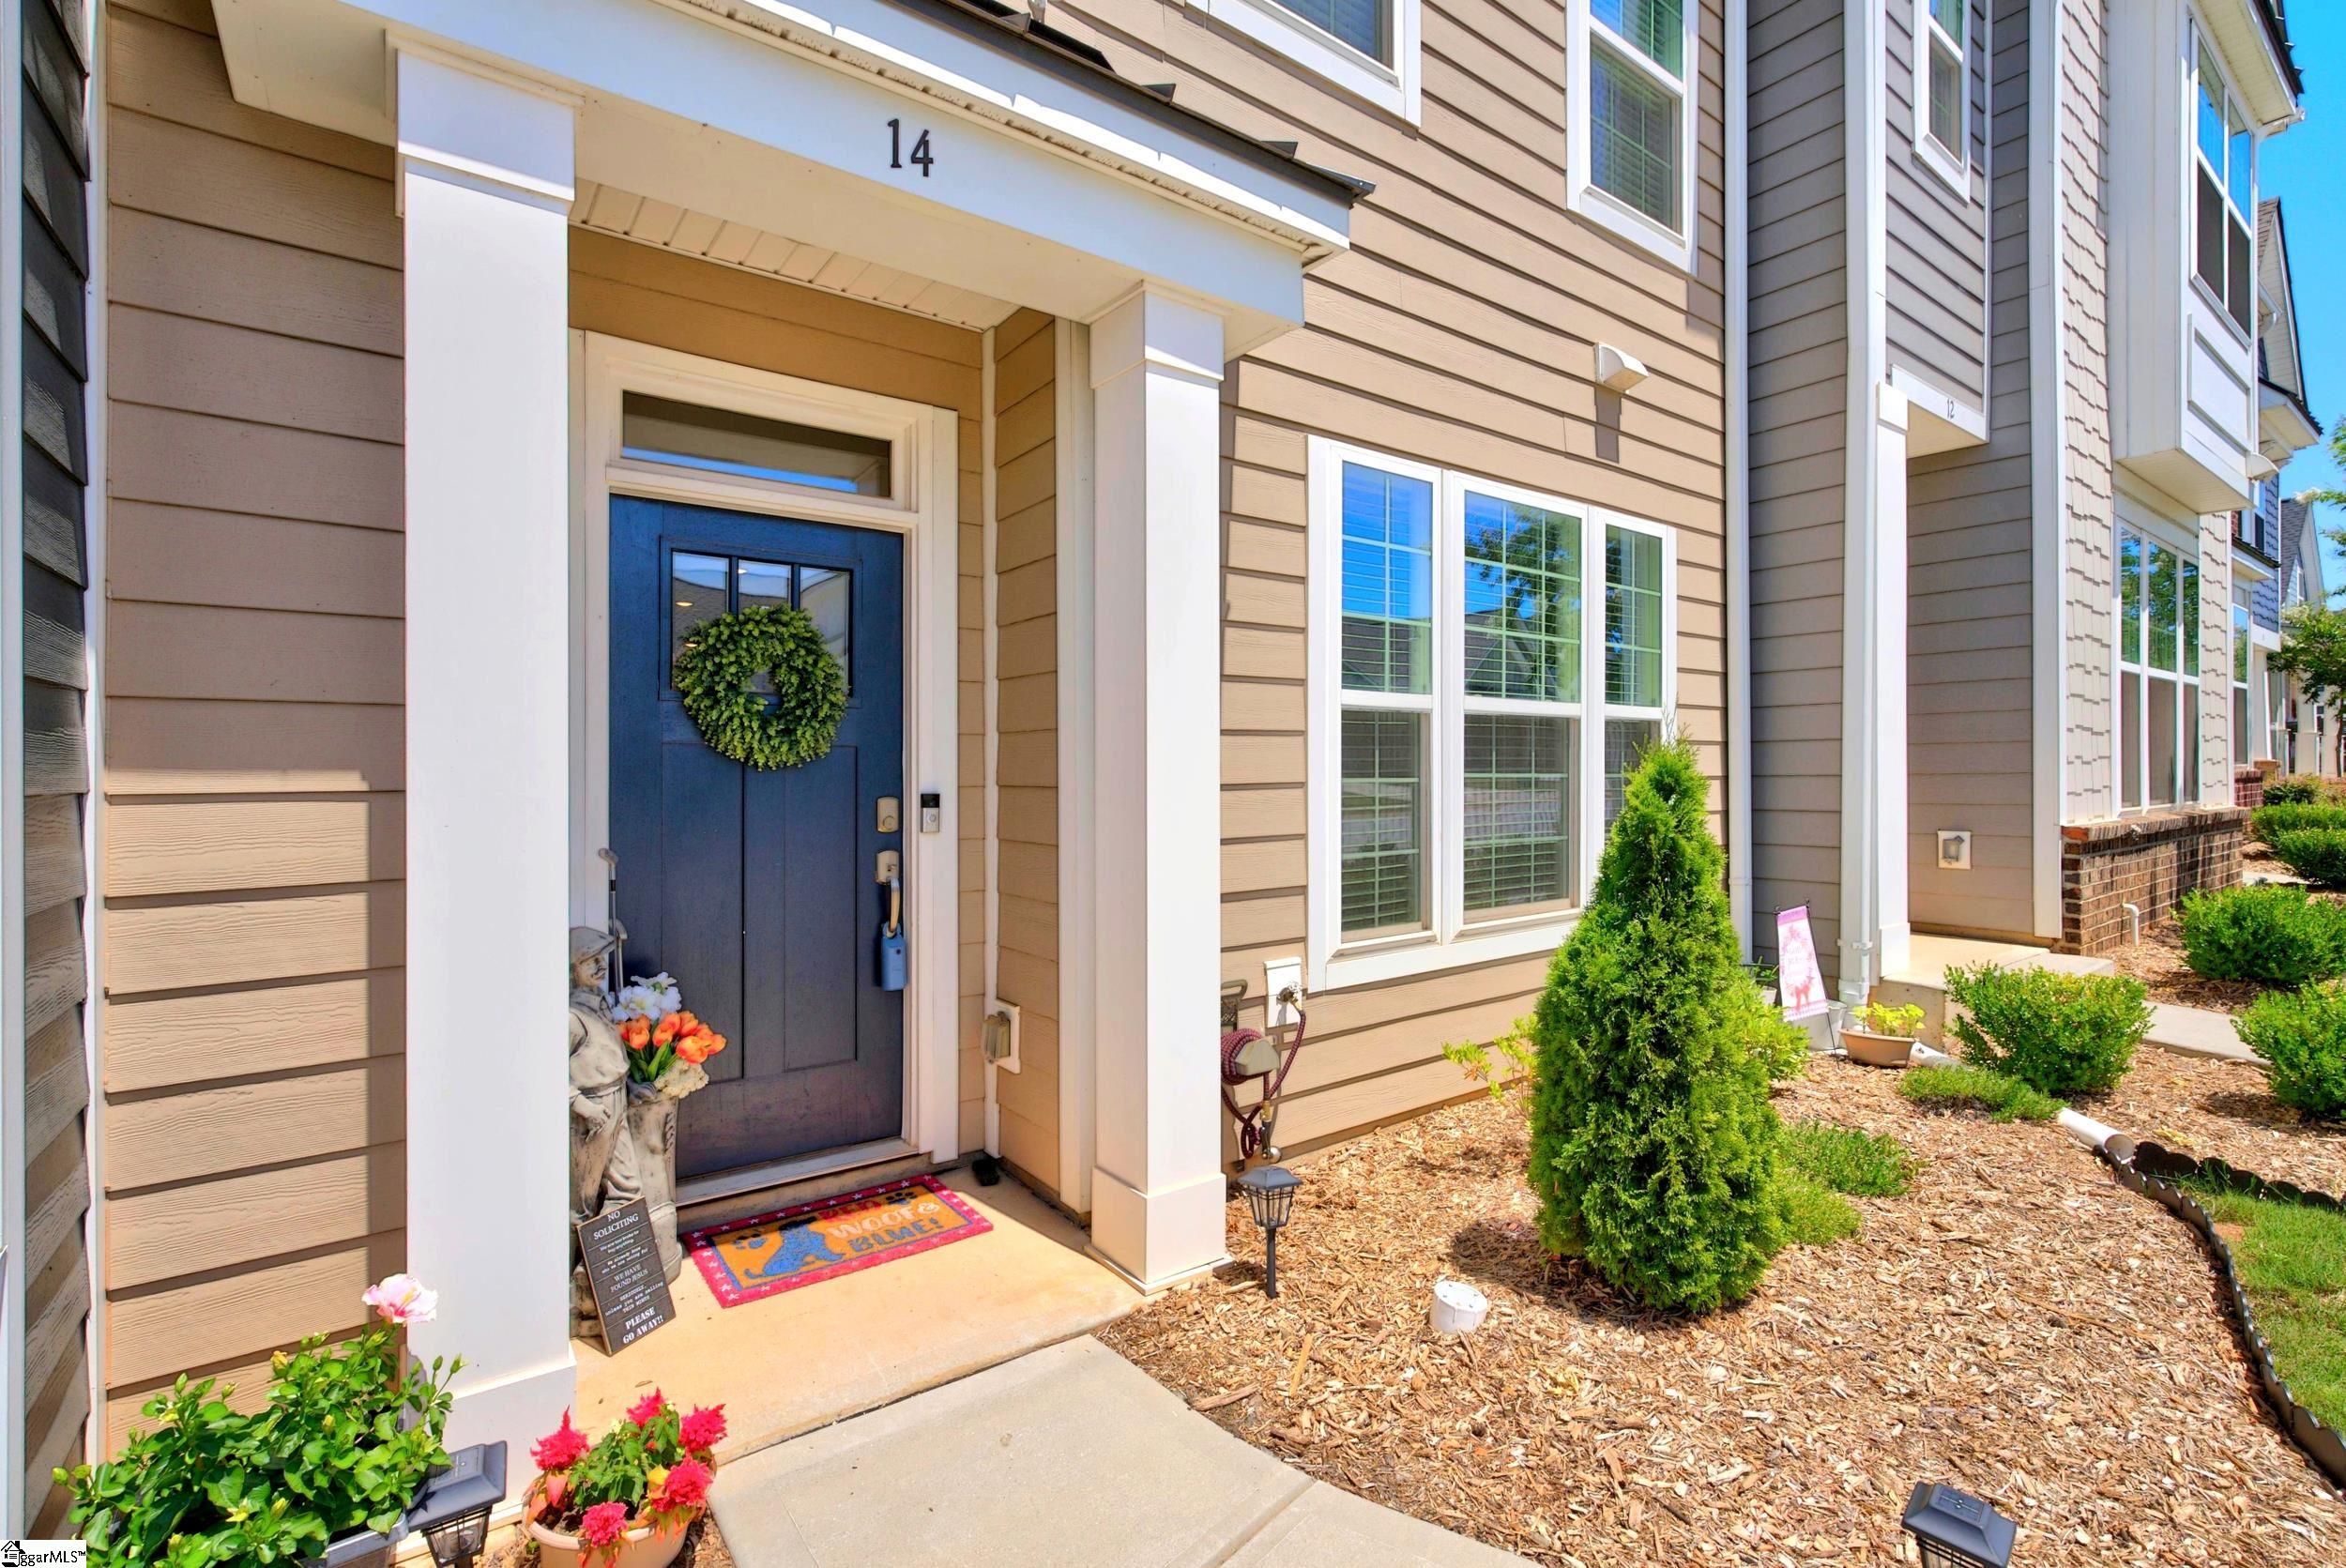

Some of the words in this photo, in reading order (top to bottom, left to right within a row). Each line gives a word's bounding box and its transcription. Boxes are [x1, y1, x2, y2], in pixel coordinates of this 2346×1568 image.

[887, 118, 934, 177] 14
[1946, 398, 1955, 419] 12
[607, 1210, 620, 1222] NO
[817, 1200, 882, 1222] RED
[826, 1206, 916, 1239] WOOF
[593, 1213, 639, 1240] SOLICITING
[848, 1217, 944, 1253] BLUE!
[610, 1278, 632, 1293] FOUND
[632, 1269, 648, 1282] JESUS
[614, 1272, 625, 1282] WE
[624, 1263, 642, 1276] HAVE
[622, 1332, 635, 1344] GO
[636, 1315, 664, 1337] AWAY!!
[625, 1306, 656, 1331] PLEASE
